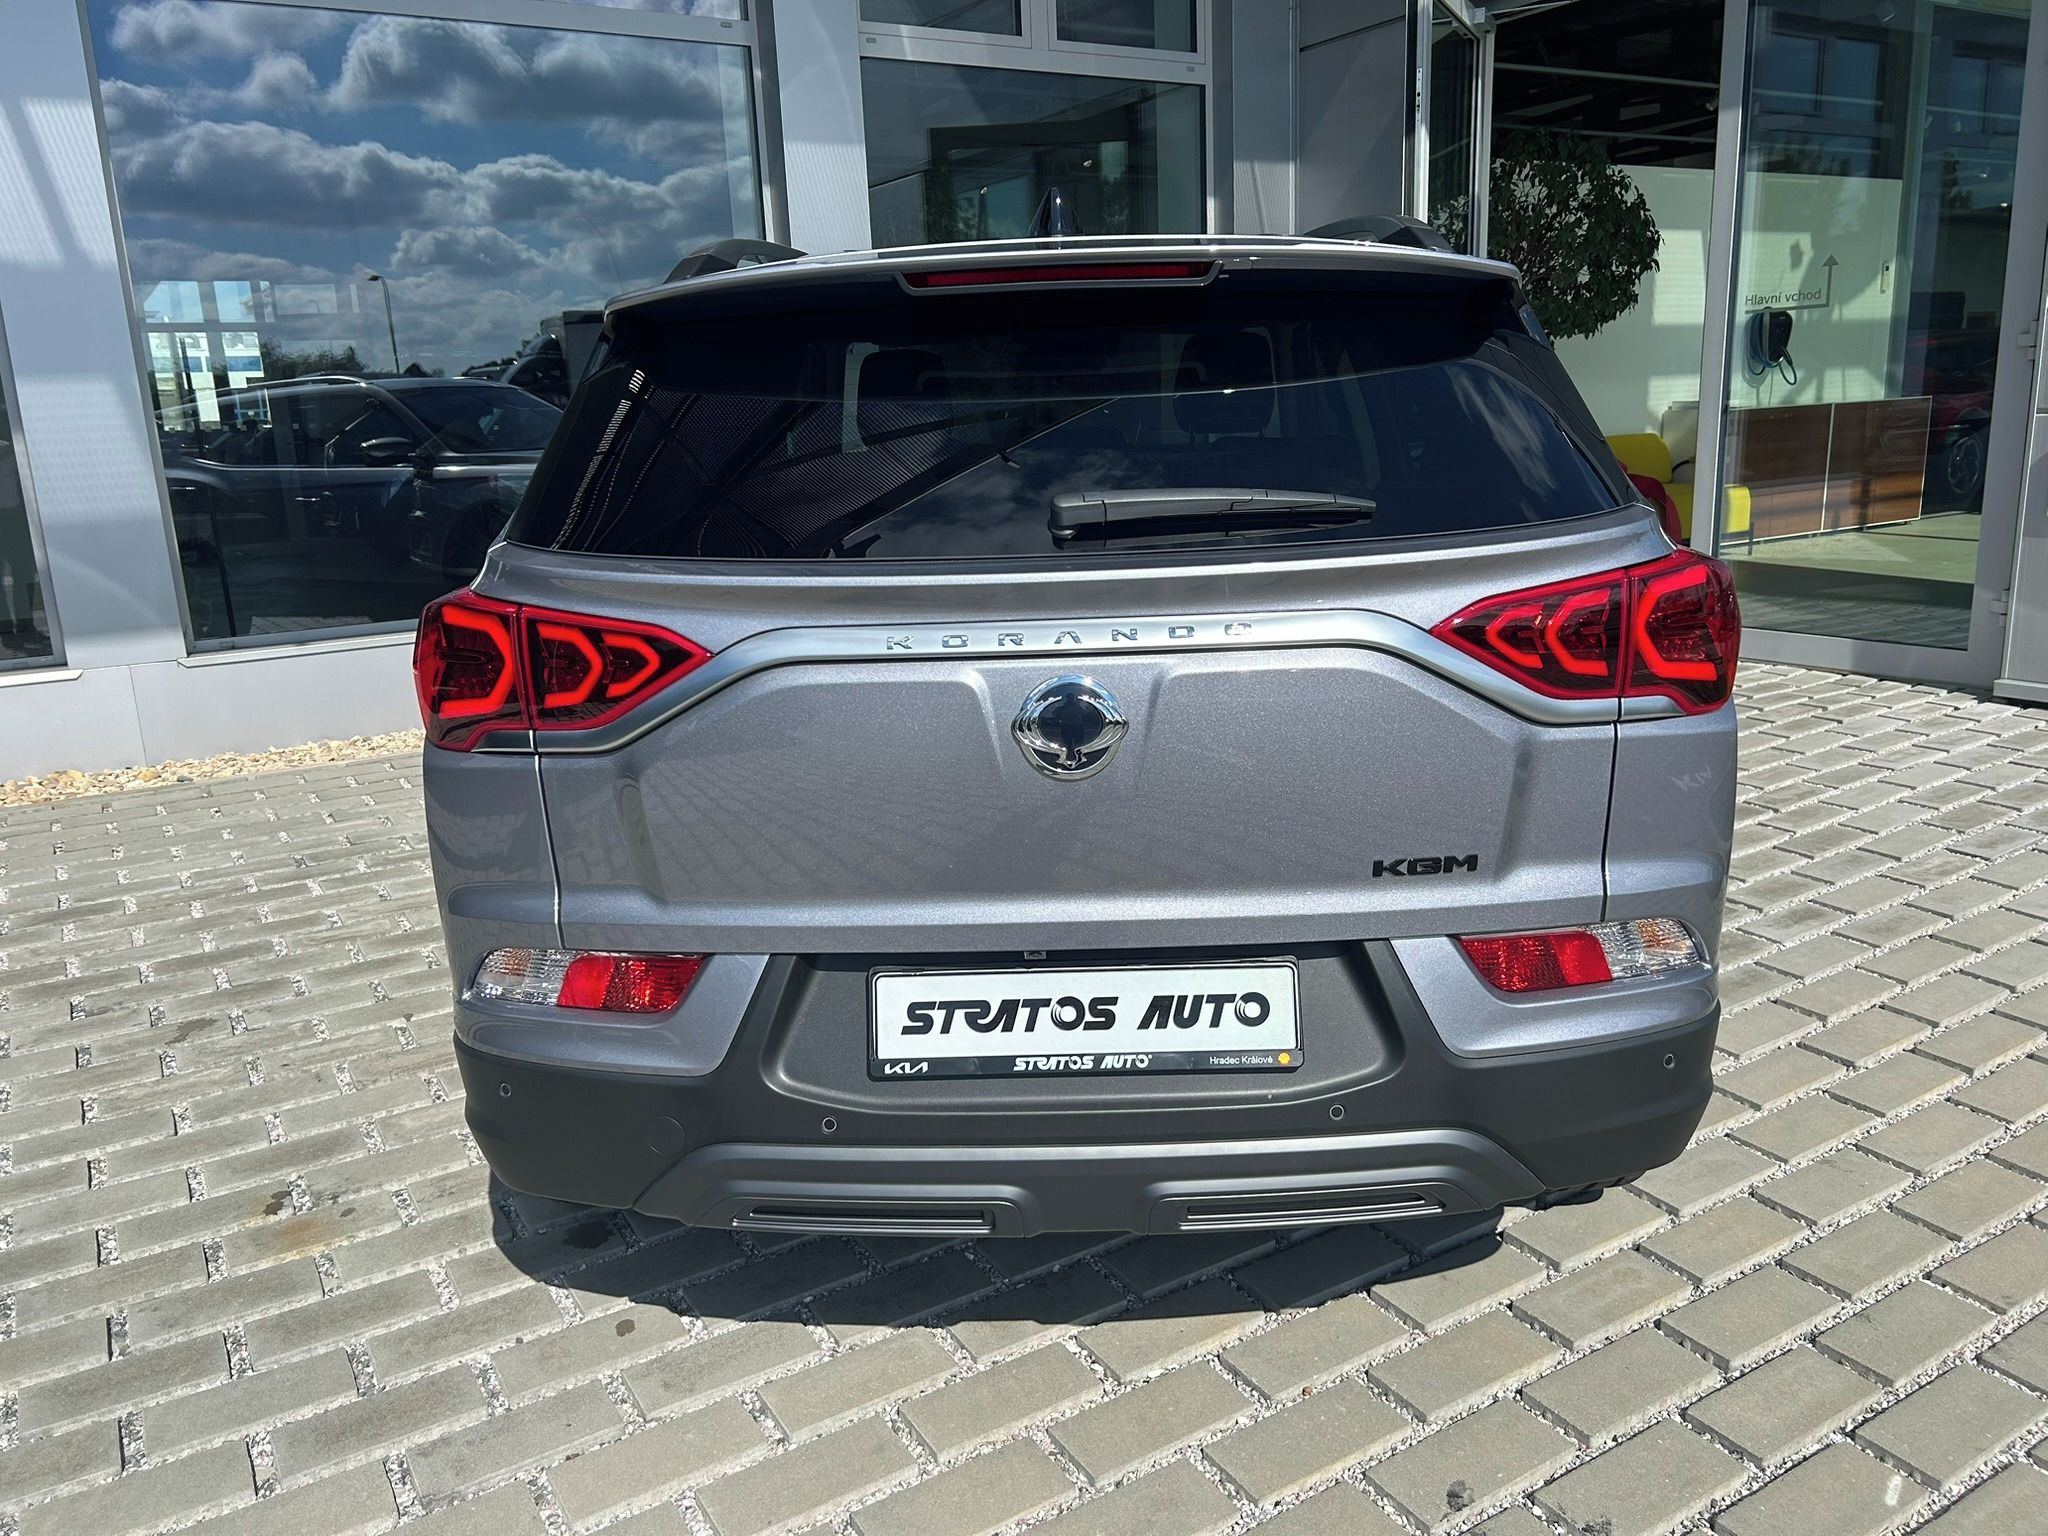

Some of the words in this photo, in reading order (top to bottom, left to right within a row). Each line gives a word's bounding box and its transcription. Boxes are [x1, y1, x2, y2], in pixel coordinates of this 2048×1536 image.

[1745, 292, 1782, 305] Hlavní
[1785, 288, 1822, 302] vchod
[886, 622, 1253, 650] KORANDO
[1372, 853, 1478, 877] KGM
[901, 996, 1118, 1035] STRATOS
[1137, 992, 1270, 1031] AUTO
[884, 1061, 929, 1075] KIA
[1013, 1055, 1094, 1072] STRATOS
[1209, 1056, 1240, 1065] Hradec
[1241, 1055, 1273, 1064] Králové
